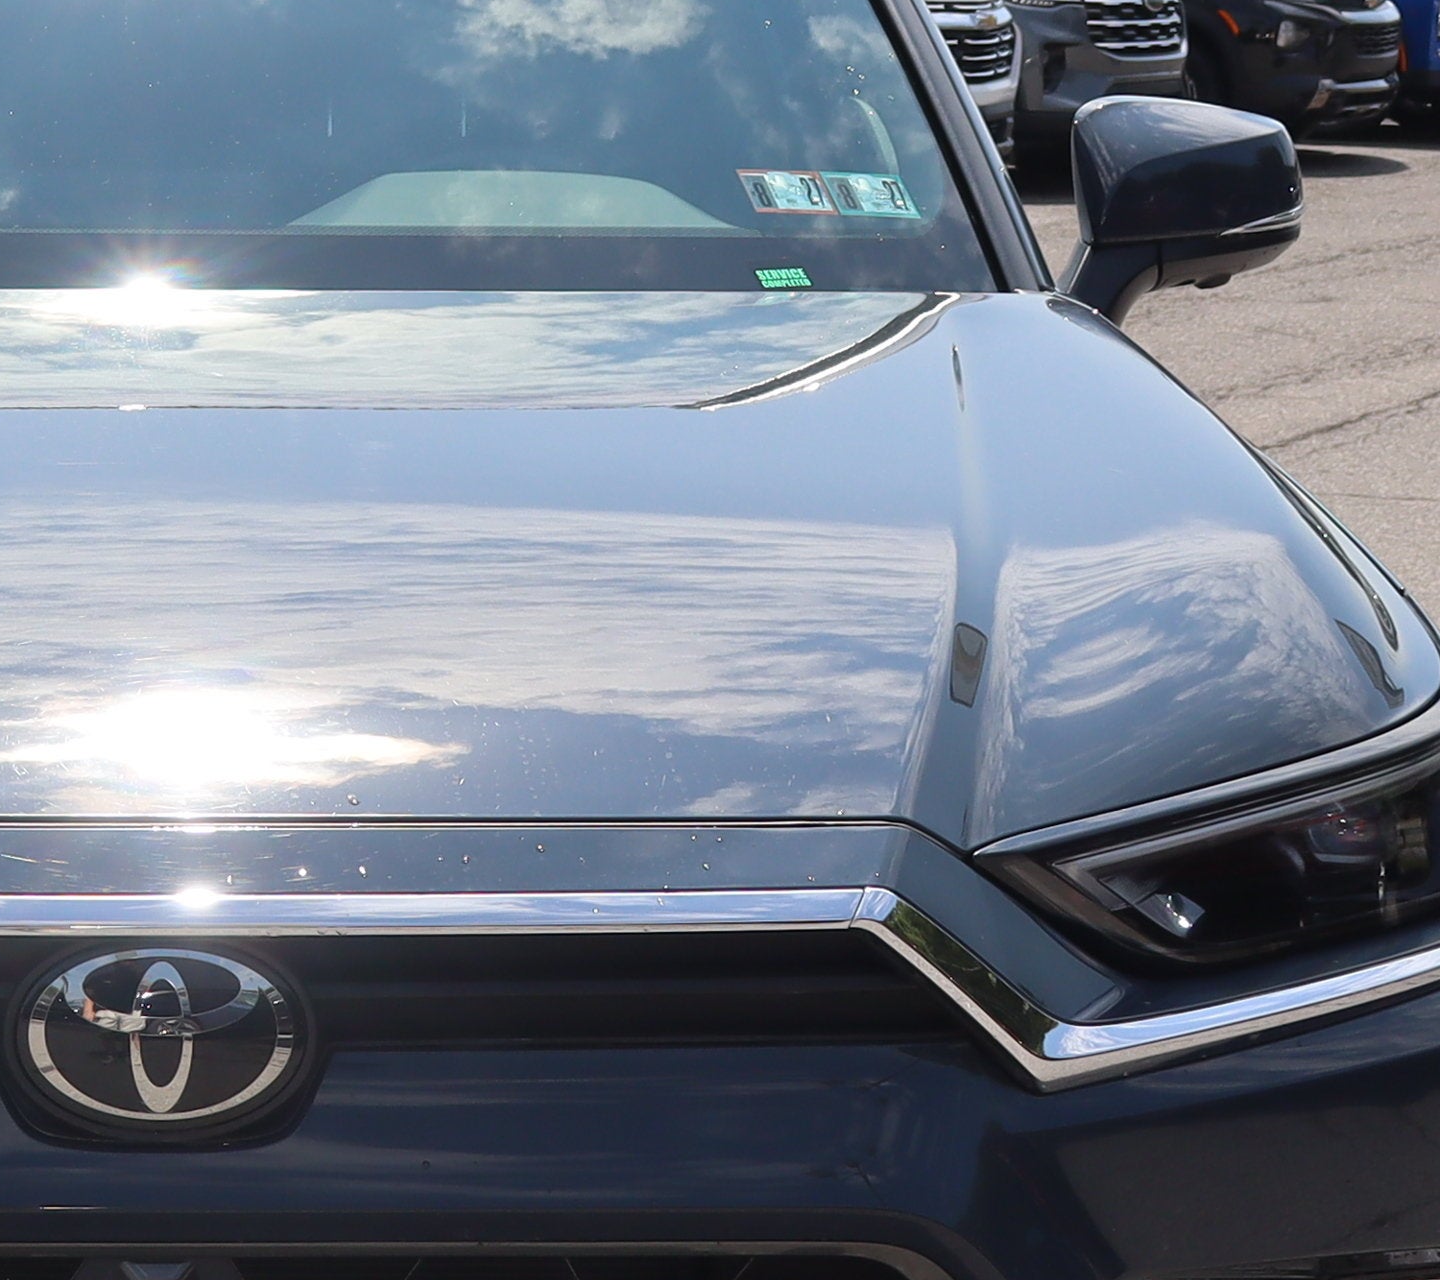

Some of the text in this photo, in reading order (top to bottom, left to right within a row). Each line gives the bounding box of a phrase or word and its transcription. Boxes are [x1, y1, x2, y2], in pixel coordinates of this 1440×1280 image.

[752, 181, 773, 208] 8
[837, 183, 859, 210] 8
[755, 268, 807, 281] SERVICE
[761, 279, 812, 288] COMPLETED
